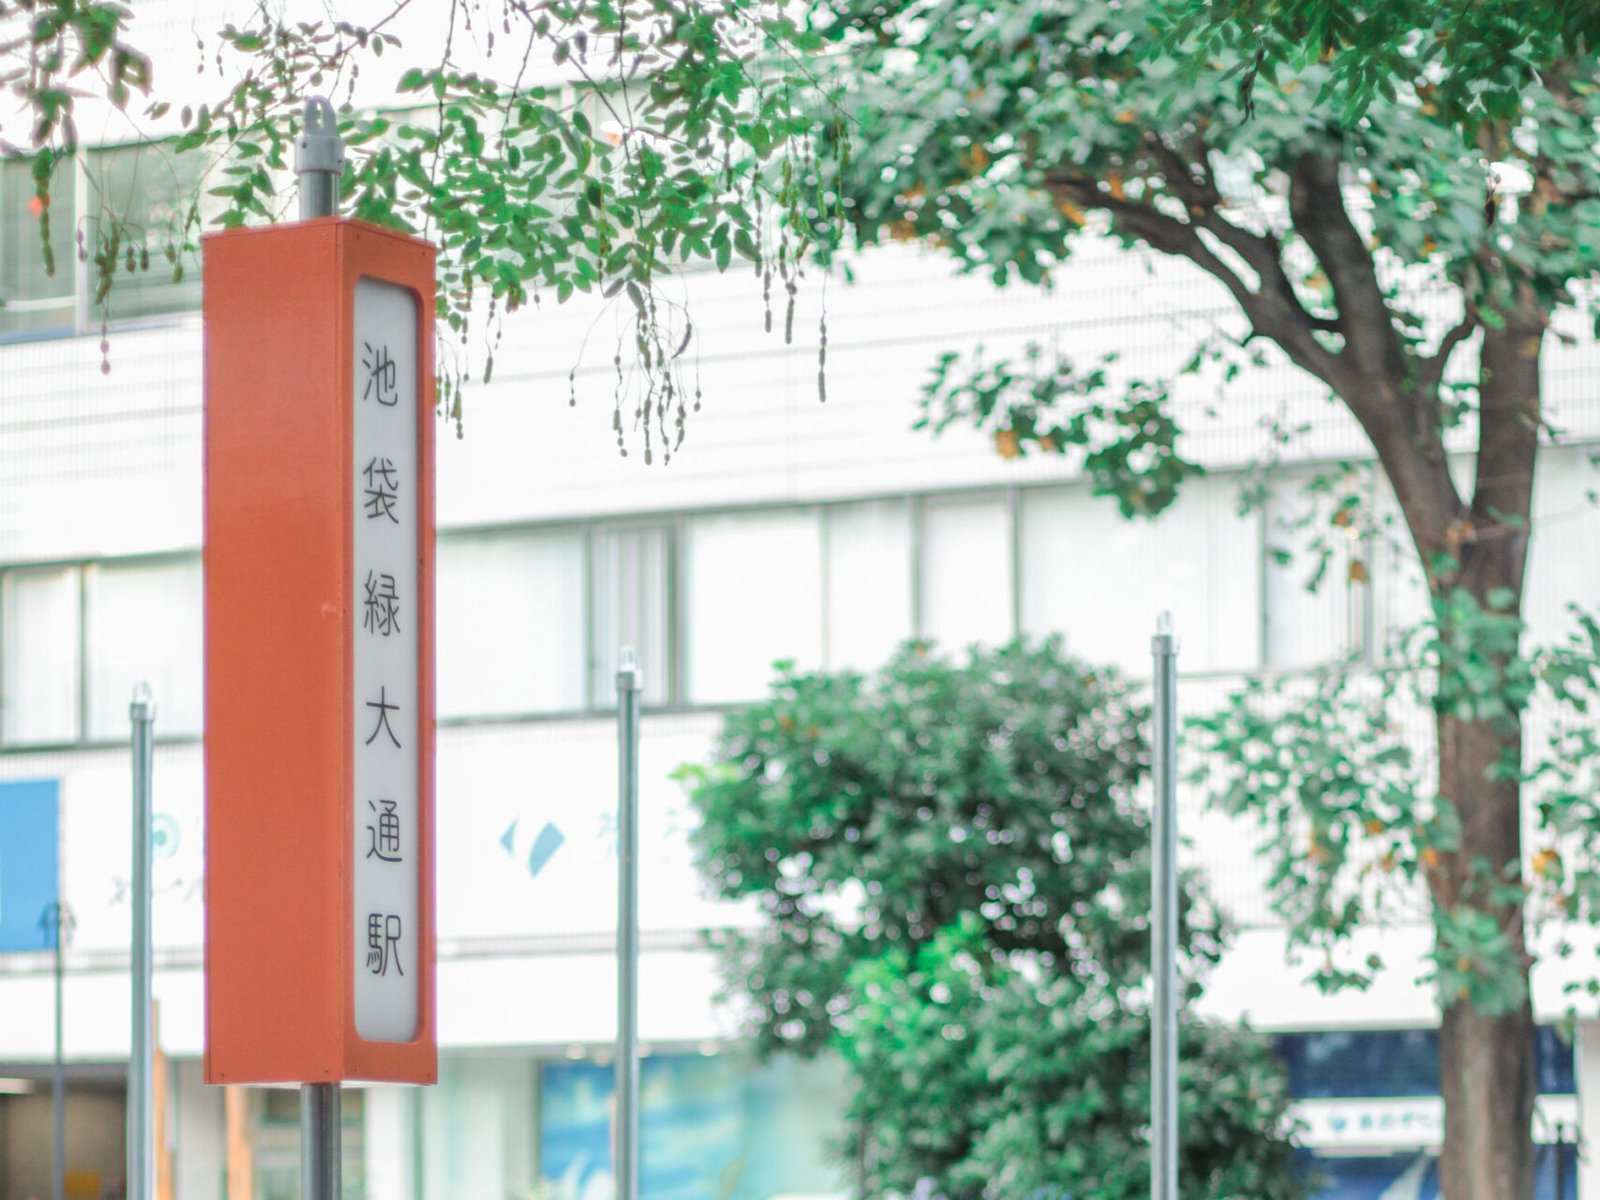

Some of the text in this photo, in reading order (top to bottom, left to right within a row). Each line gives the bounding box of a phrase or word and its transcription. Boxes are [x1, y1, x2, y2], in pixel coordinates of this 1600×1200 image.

[362, 341, 405, 978] 池袋緑大通駅
